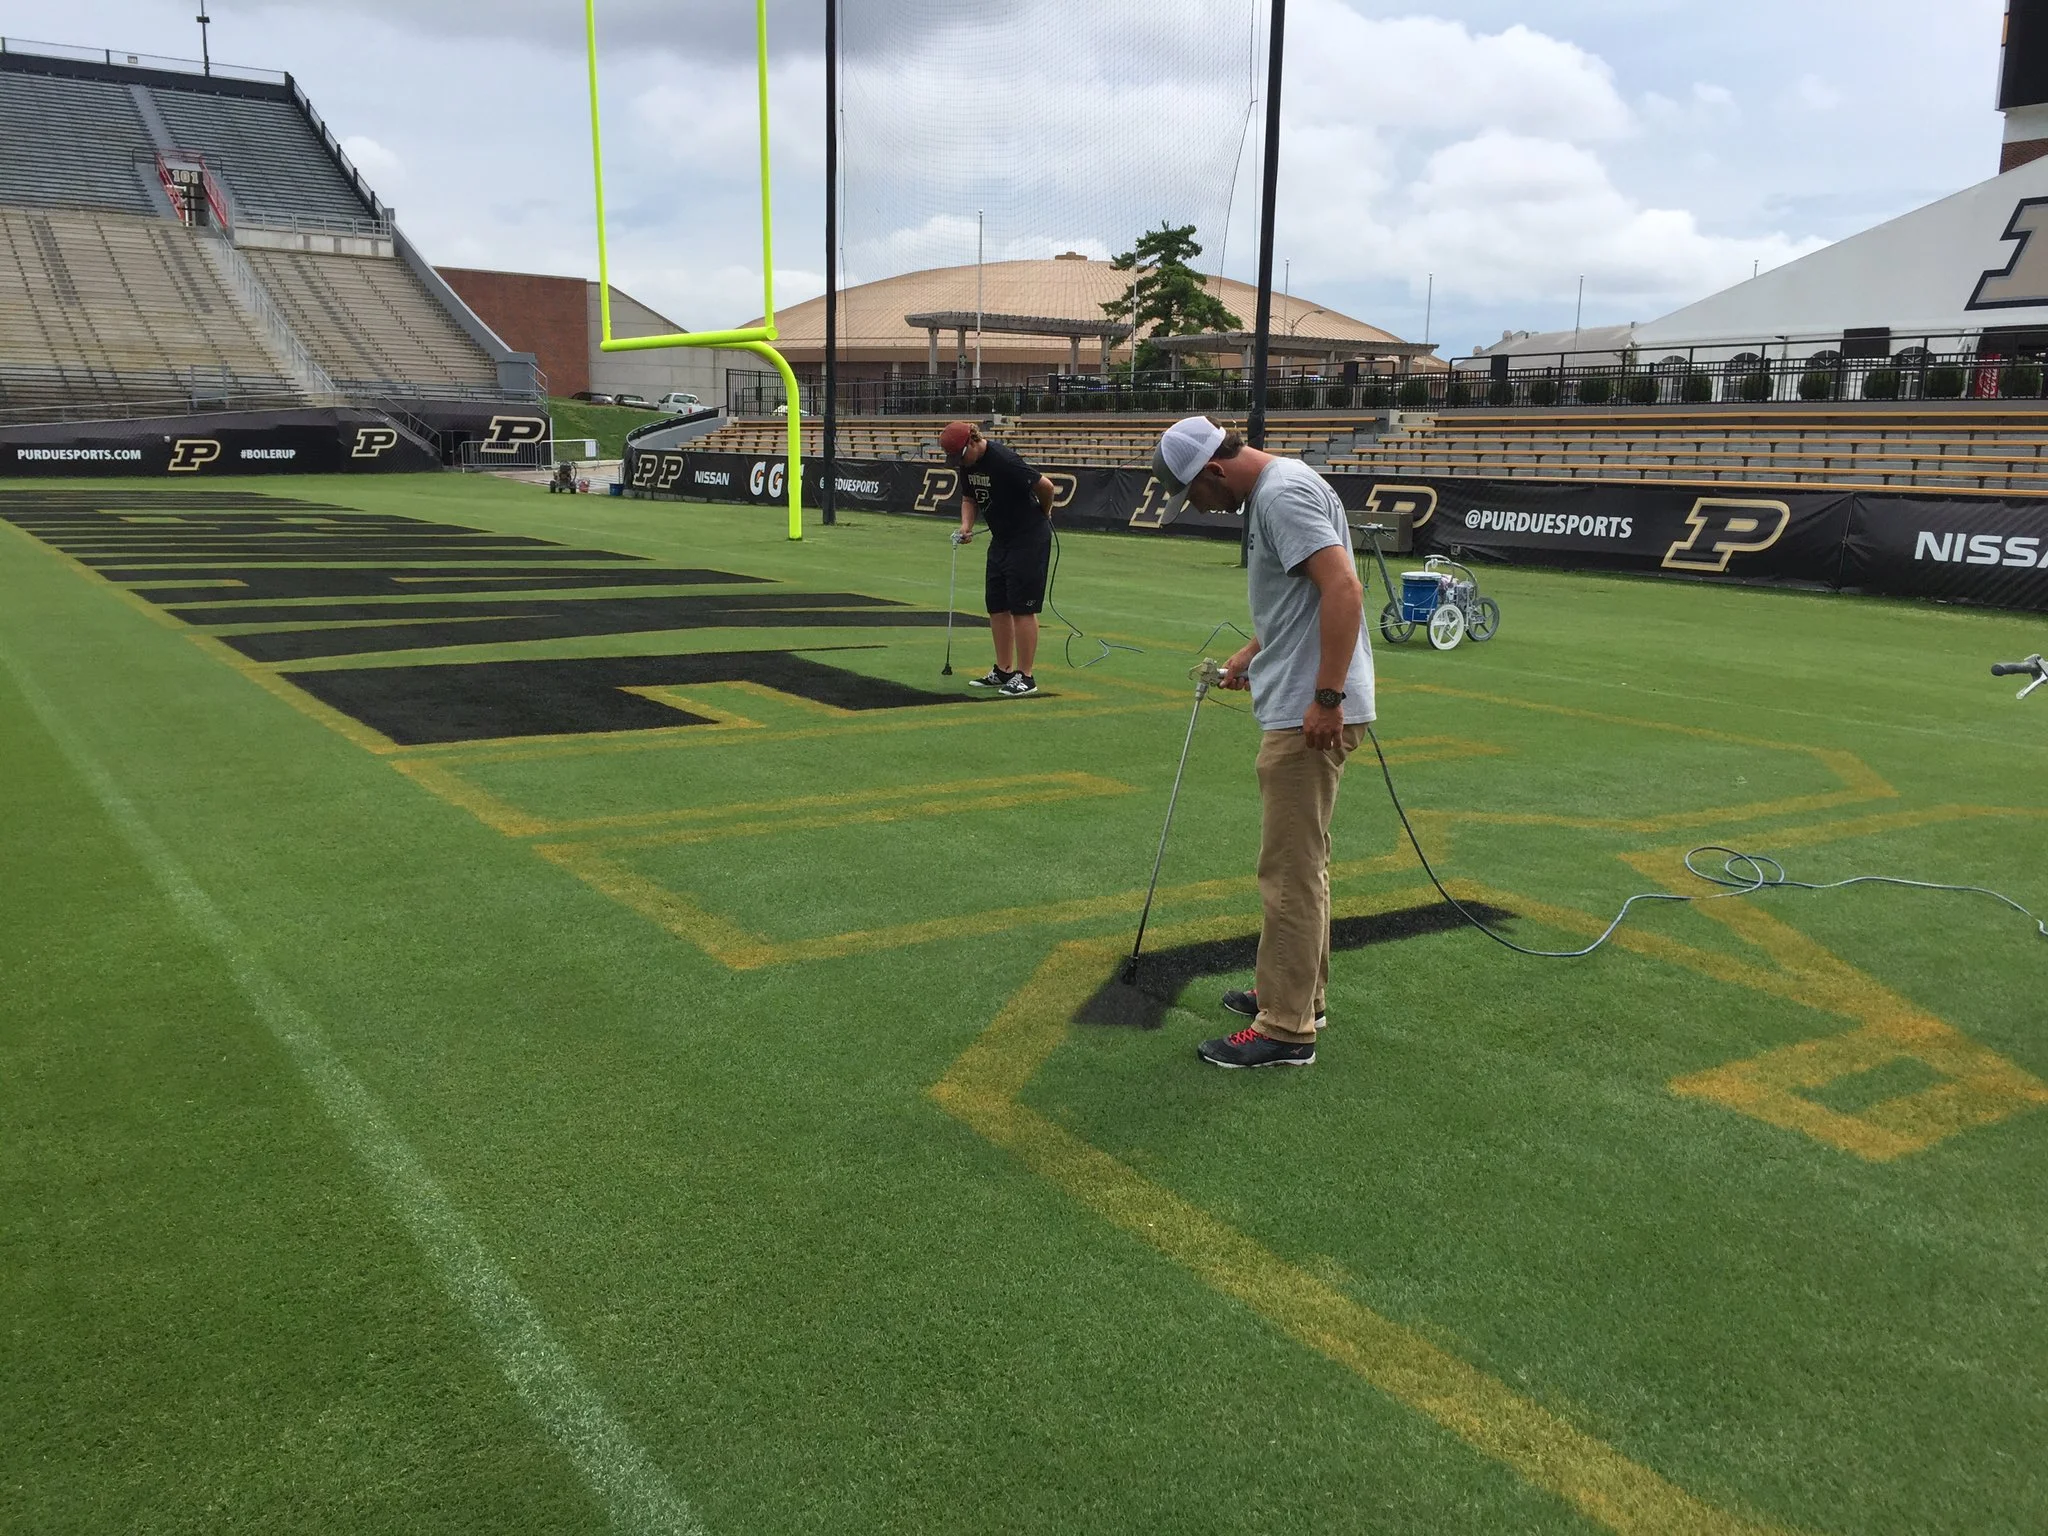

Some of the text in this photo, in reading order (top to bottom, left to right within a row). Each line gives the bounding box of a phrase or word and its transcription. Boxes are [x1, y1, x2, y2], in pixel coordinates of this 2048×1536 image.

[172, 170, 199, 184] 101
[351, 428, 397, 457] P
[480, 415, 546, 454] P
[17, 449, 142, 460] PURDUESPORTS.COM
[168, 440, 220, 470] P
[240, 449, 296, 459] #BOILERUP
[694, 470, 730, 486] NISSAN
[914, 468, 958, 512] P
[1465, 509, 1633, 539] @PURDUESPORTS
[1660, 497, 1791, 573] P
[1914, 530, 2048, 569] NISS
